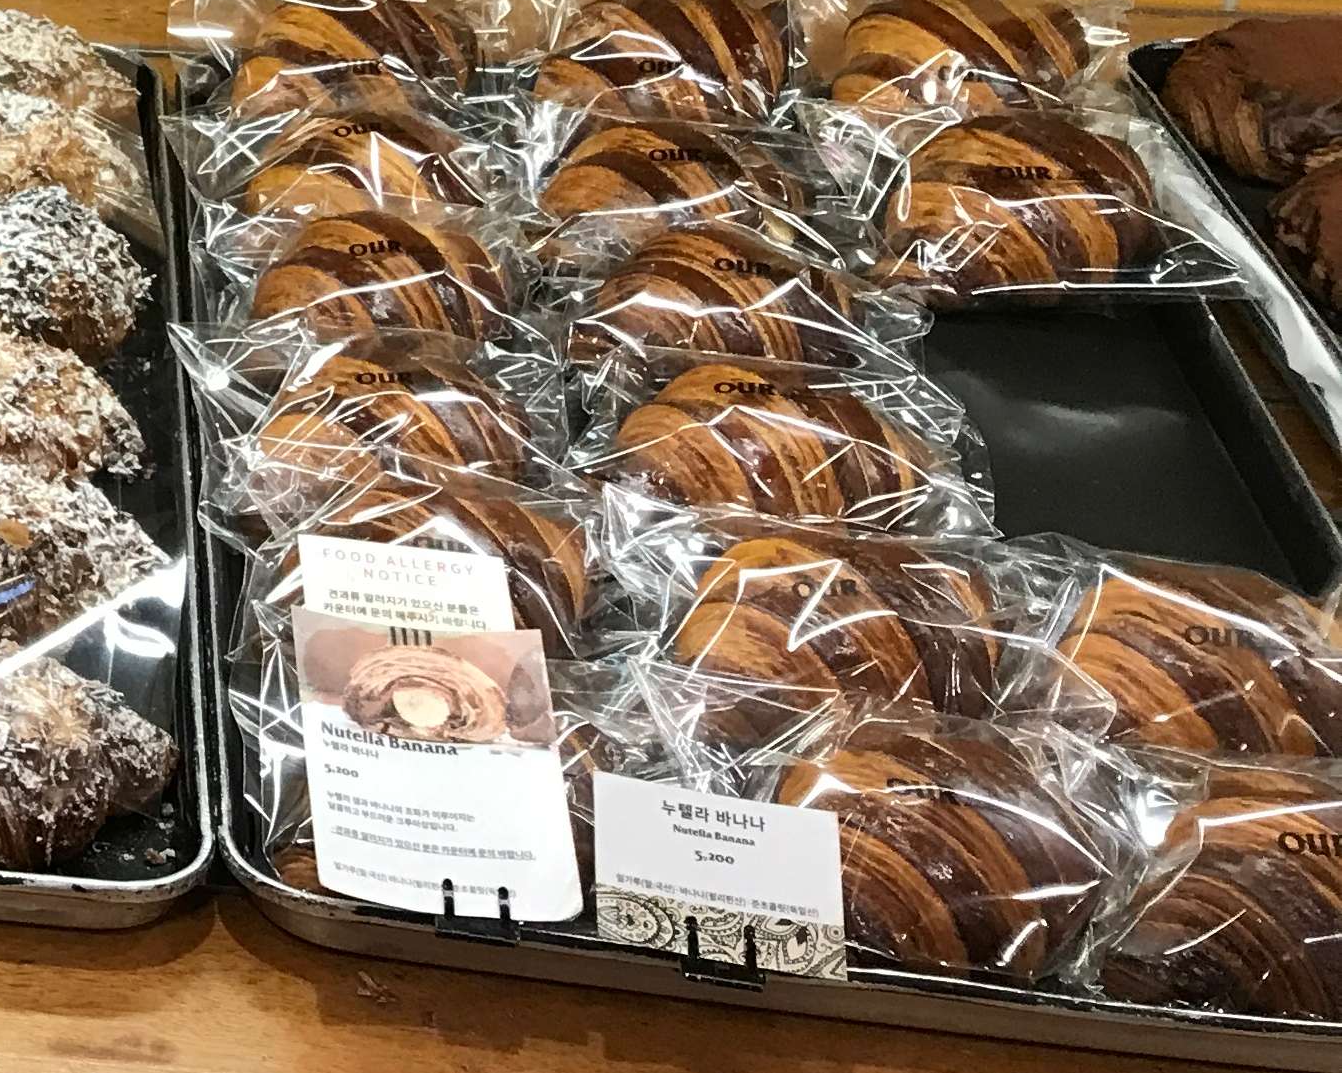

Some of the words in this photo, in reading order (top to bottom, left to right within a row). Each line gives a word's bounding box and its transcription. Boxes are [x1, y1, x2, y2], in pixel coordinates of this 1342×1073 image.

[349, 239, 402, 257] OUR
[713, 257, 772, 276] OUR
[713, 381, 775, 395] OUR
[322, 548, 377, 565] FOOD
[386, 554, 475, 576] ALLERGY
[363, 568, 438, 587] NOTICE
[321, 721, 385, 747] Nutella
[388, 735, 459, 756] Banana
[661, 799, 710, 823] 누텔라
[716, 807, 766, 833] 바나나
[673, 823, 713, 840] Nutella
[714, 832, 756, 847] Banana
